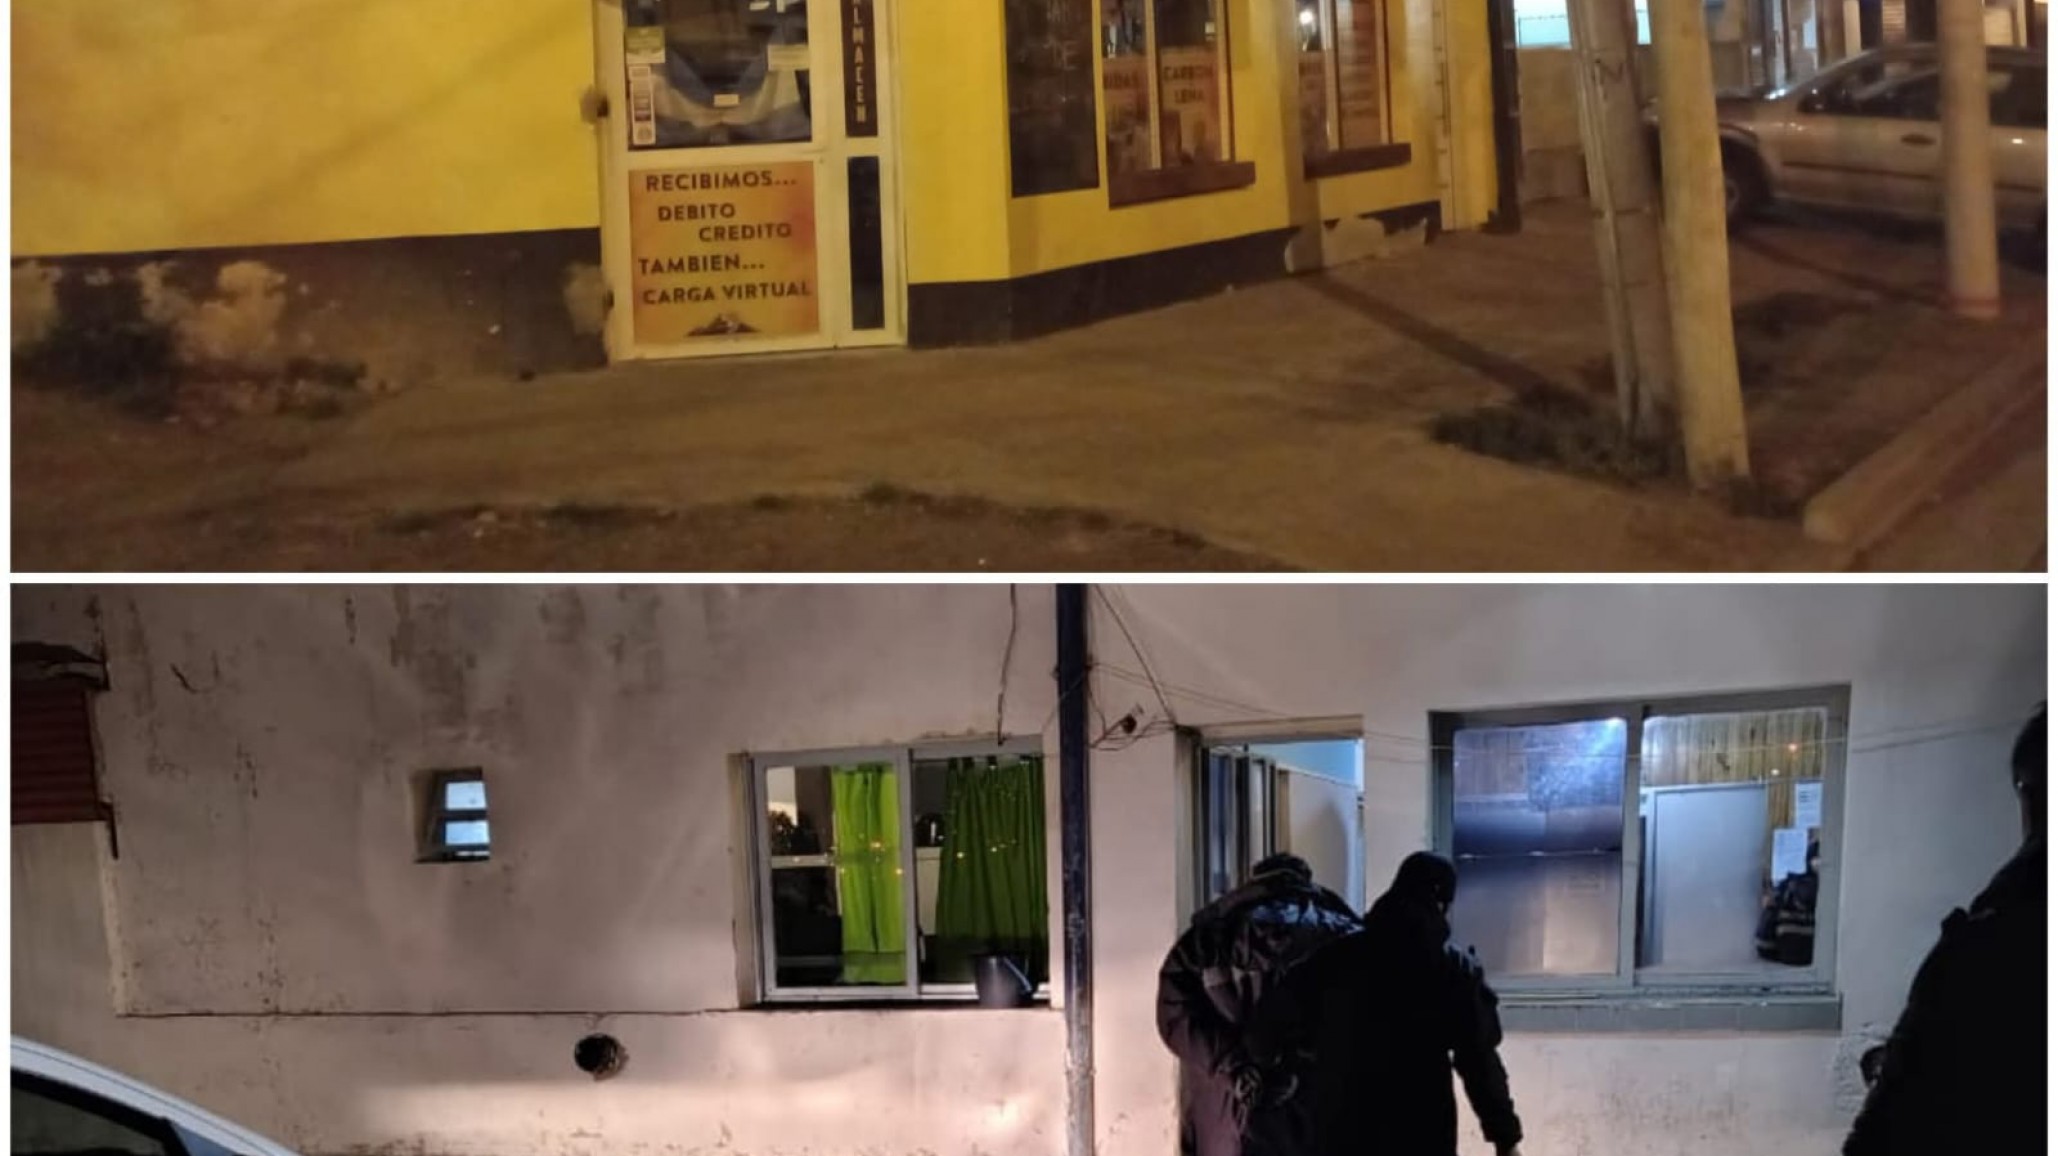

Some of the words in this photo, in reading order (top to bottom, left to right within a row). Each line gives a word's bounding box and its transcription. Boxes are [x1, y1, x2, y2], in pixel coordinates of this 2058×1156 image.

[852, 0, 866, 122] LMACEN
[645, 170, 798, 192] RECIBIMOS...
[657, 203, 735, 221] DEBITO
[698, 223, 792, 242] CREDITO
[638, 254, 765, 275] TAMBIEN...
[642, 287, 716, 305] CARGA
[722, 281, 812, 301] VIRTUAL
